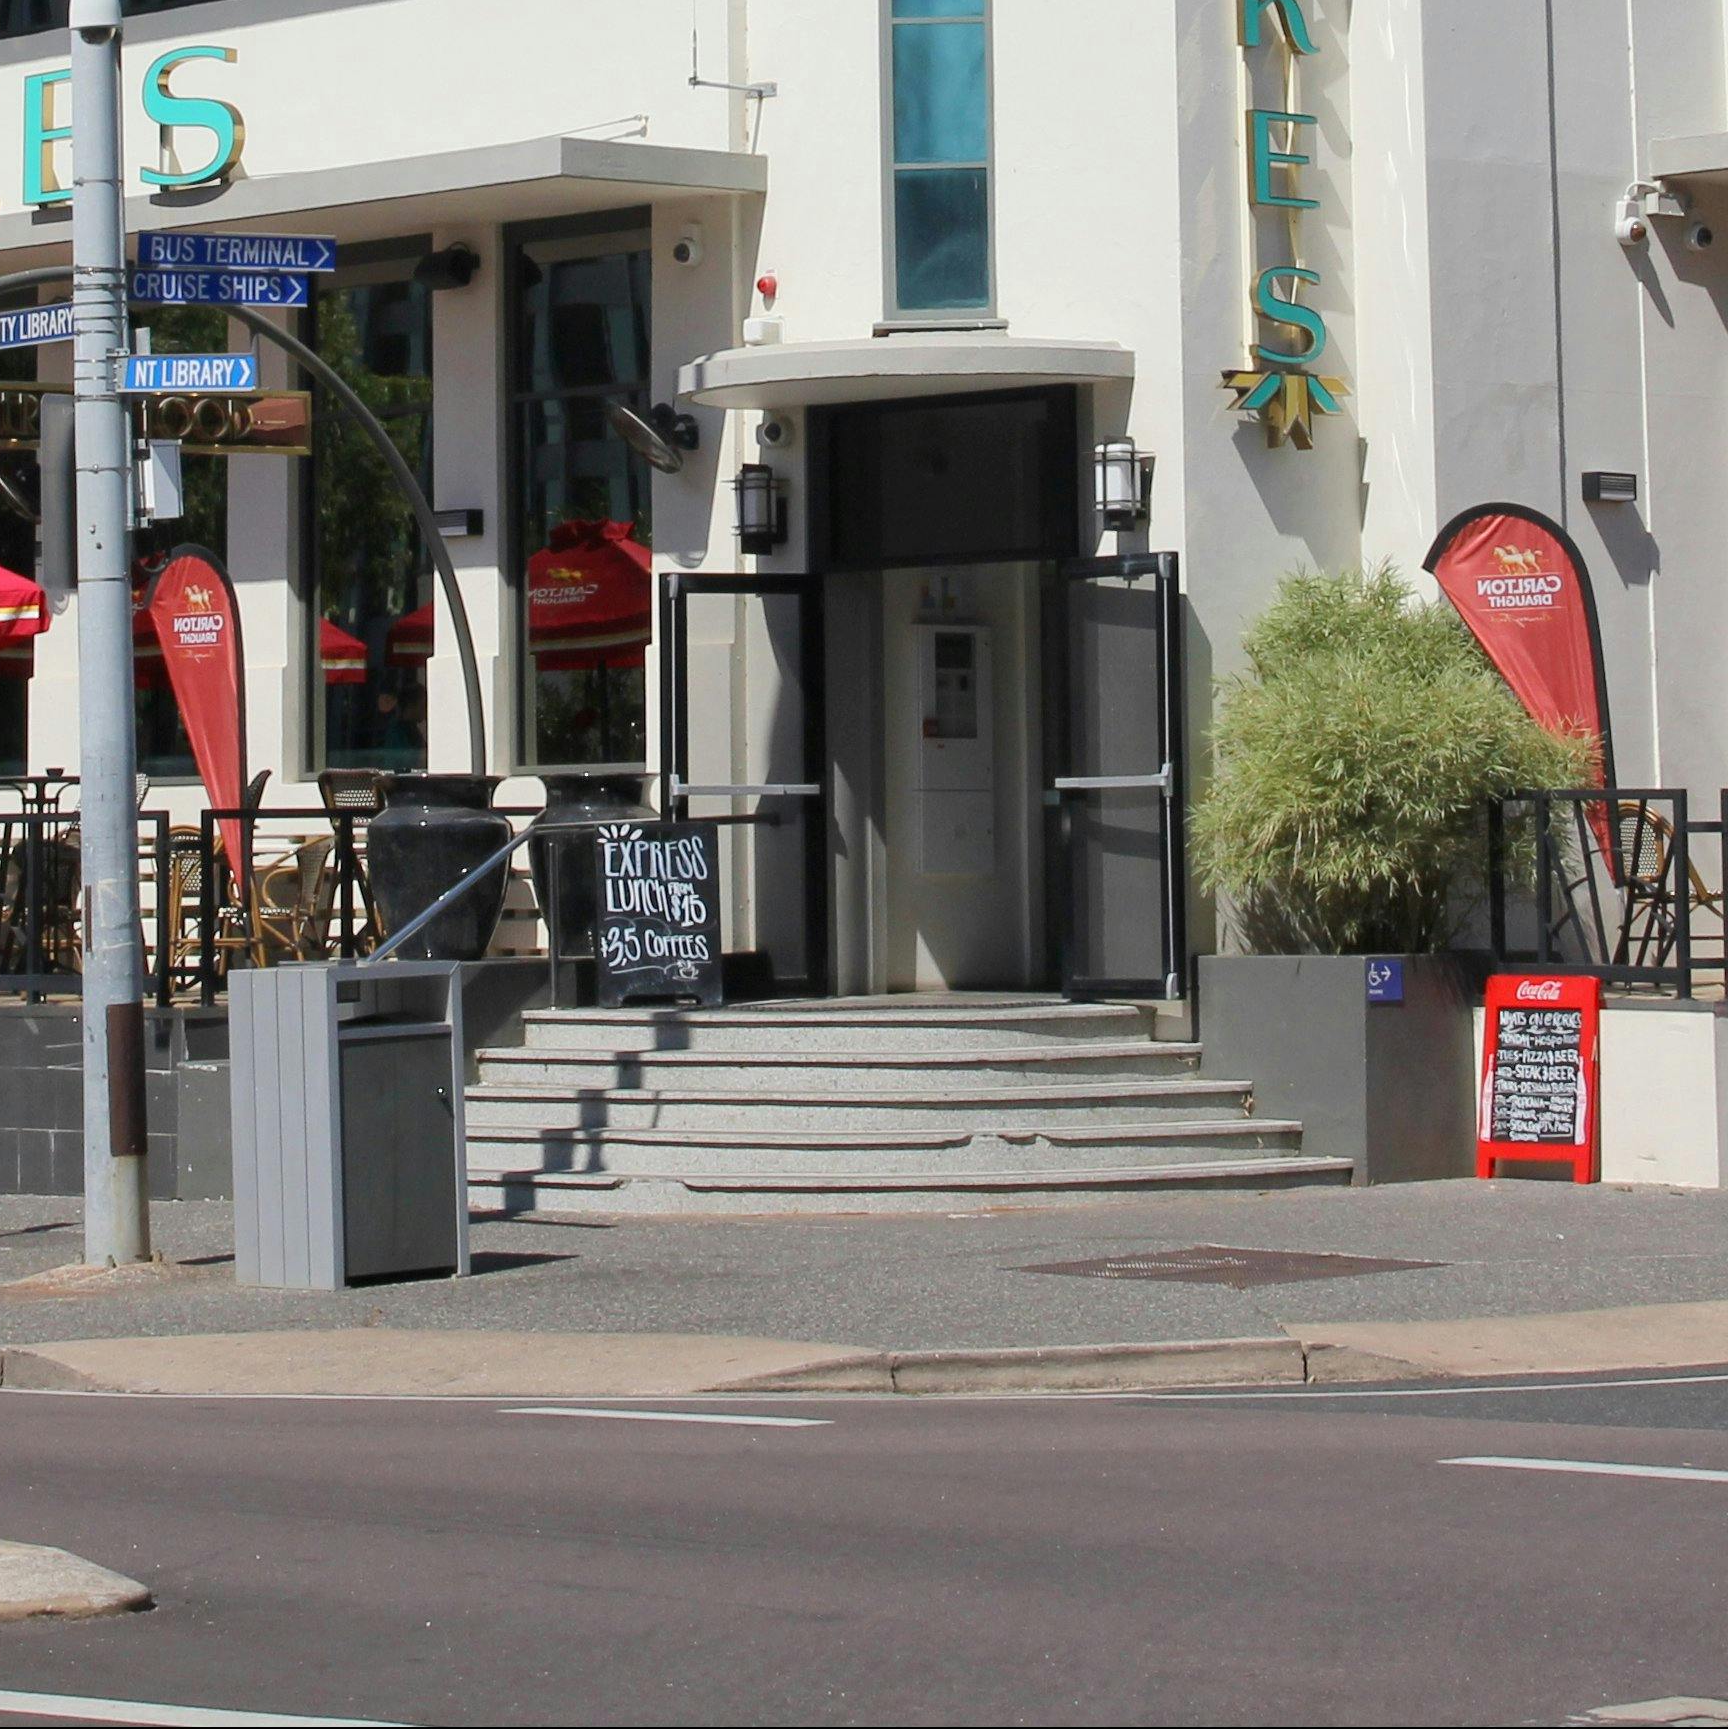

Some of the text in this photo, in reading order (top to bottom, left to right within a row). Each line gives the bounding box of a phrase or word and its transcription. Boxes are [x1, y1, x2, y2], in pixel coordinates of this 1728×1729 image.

[150, 235, 310, 267] BUS TERMINAL
[133, 271, 282, 303] CRUISE SHIPS
[18, 308, 74, 340] LIBRARY
[134, 359, 234, 387] NT LIBRARY
[603, 835, 708, 881] EXPRESS
[668, 882, 695, 897] FROM
[671, 894, 707, 927] $15
[1516, 980, 1564, 1001] Coca-Cola
[1554, 1049, 1580, 1065] BEER
[1548, 1065, 1577, 1081] BEER
